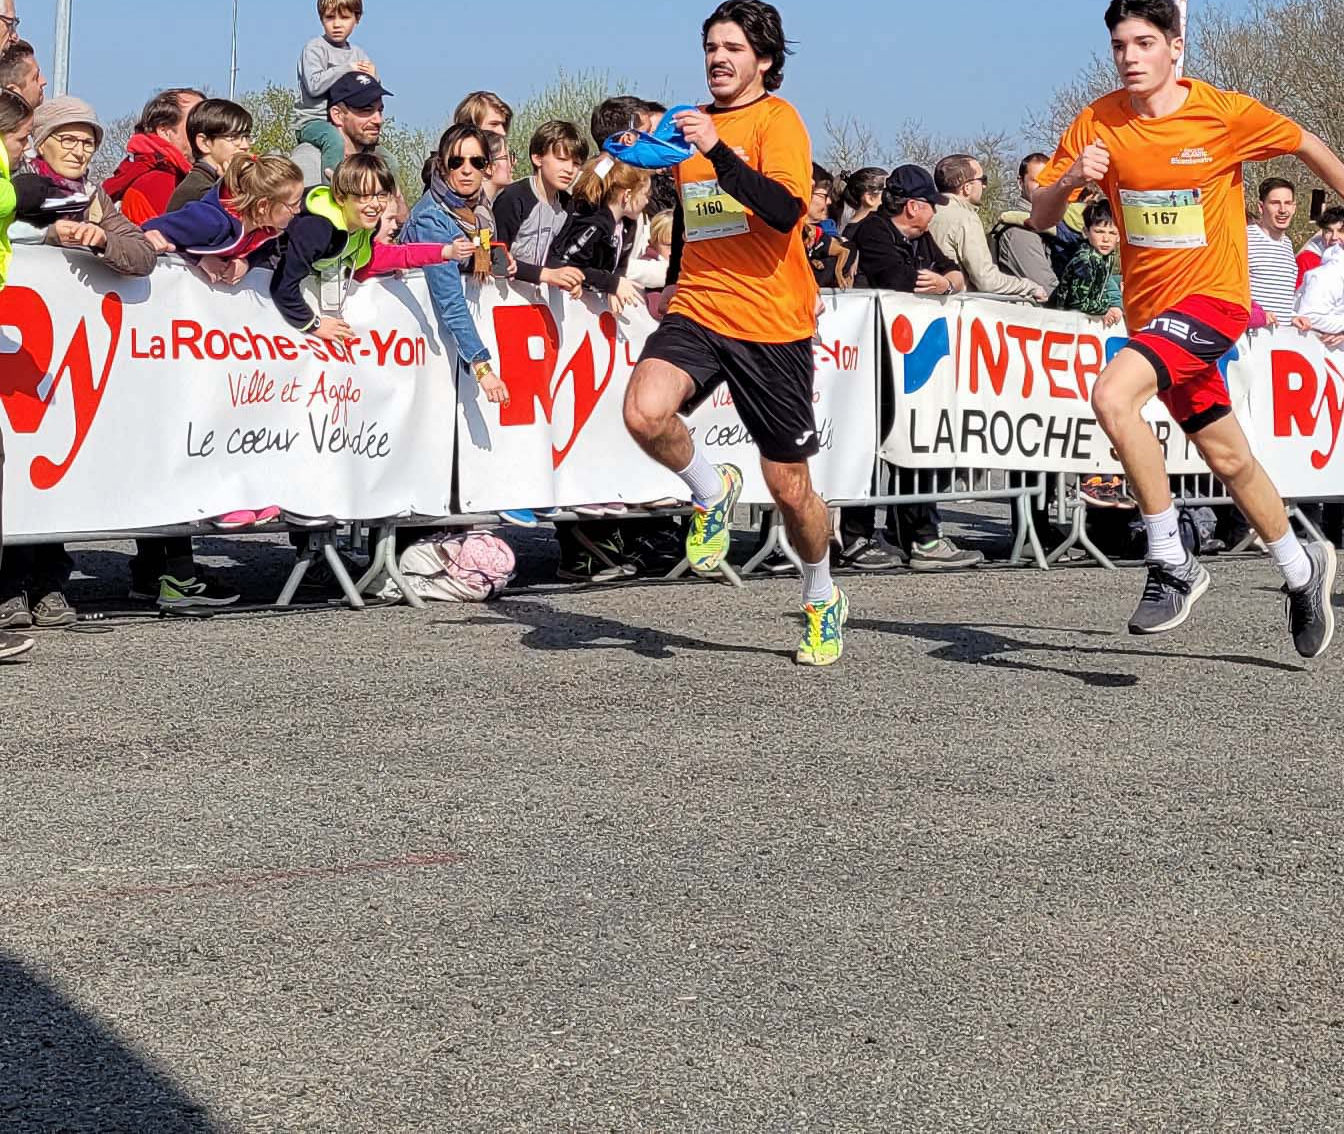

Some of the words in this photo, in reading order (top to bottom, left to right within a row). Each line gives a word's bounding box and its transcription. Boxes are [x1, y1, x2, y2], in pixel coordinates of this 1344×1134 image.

[696, 200, 723, 216] 1160
[1142, 211, 1178, 225] 1167
[130, 327, 164, 360] La
[171, 318, 426, 367] Roche-sur-Yon
[227, 369, 275, 408] Ville
[280, 375, 300, 403] et
[306, 374, 362, 424] Agglo
[186, 421, 215, 459] Le
[307, 412, 392, 459] Vendée
